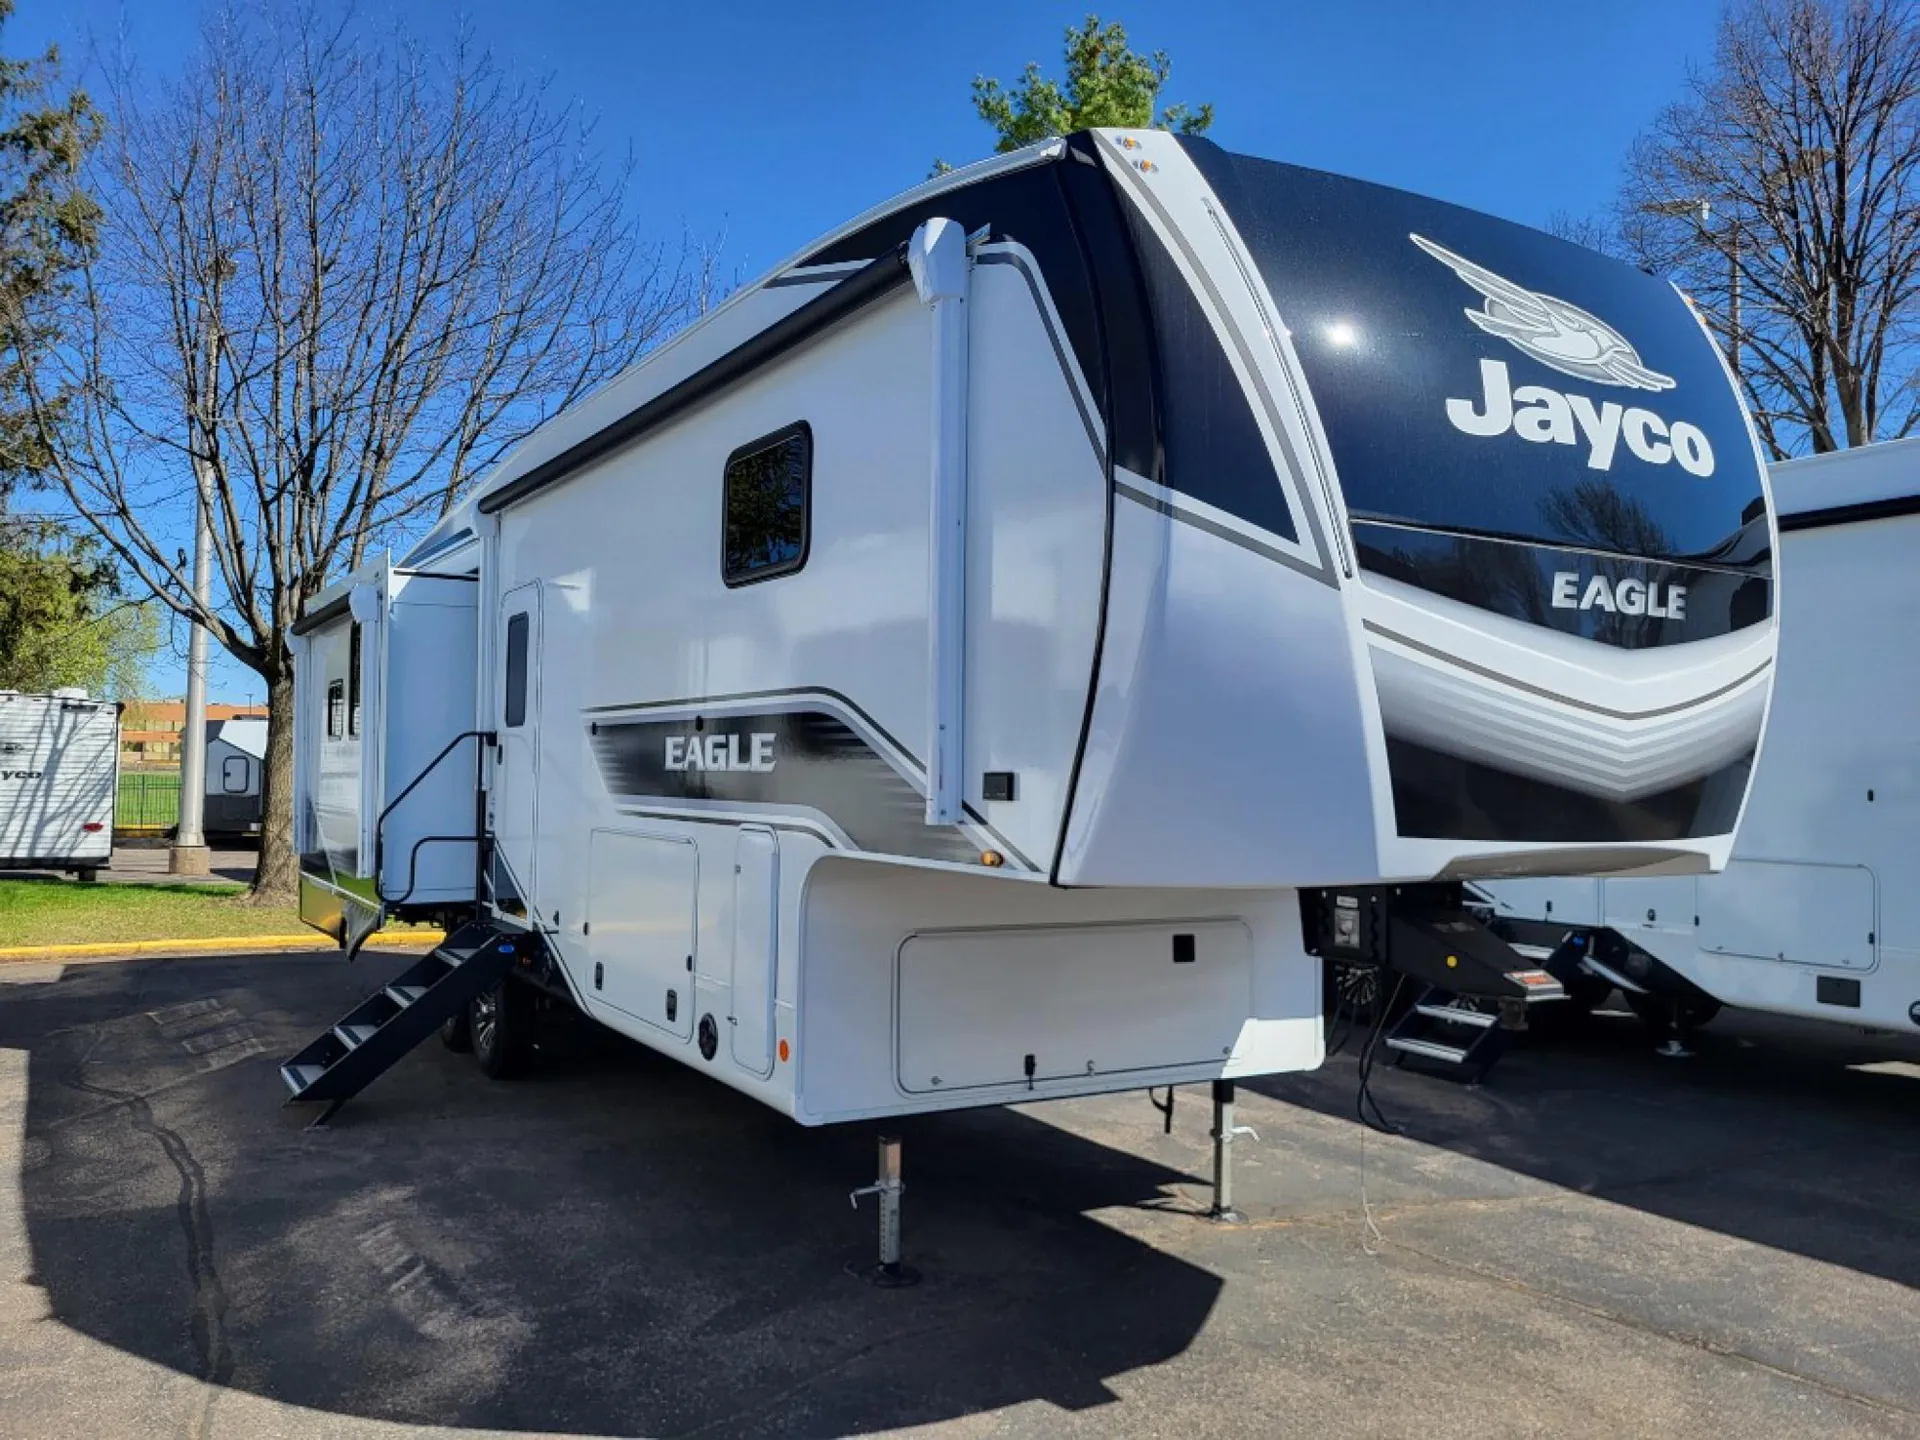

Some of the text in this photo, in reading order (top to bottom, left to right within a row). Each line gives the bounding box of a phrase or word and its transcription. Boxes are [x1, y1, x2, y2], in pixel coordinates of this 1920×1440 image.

[1446, 359, 1715, 477] Jayco
[1552, 572, 1686, 619] EAGLE
[665, 733, 777, 773] EAGLE
